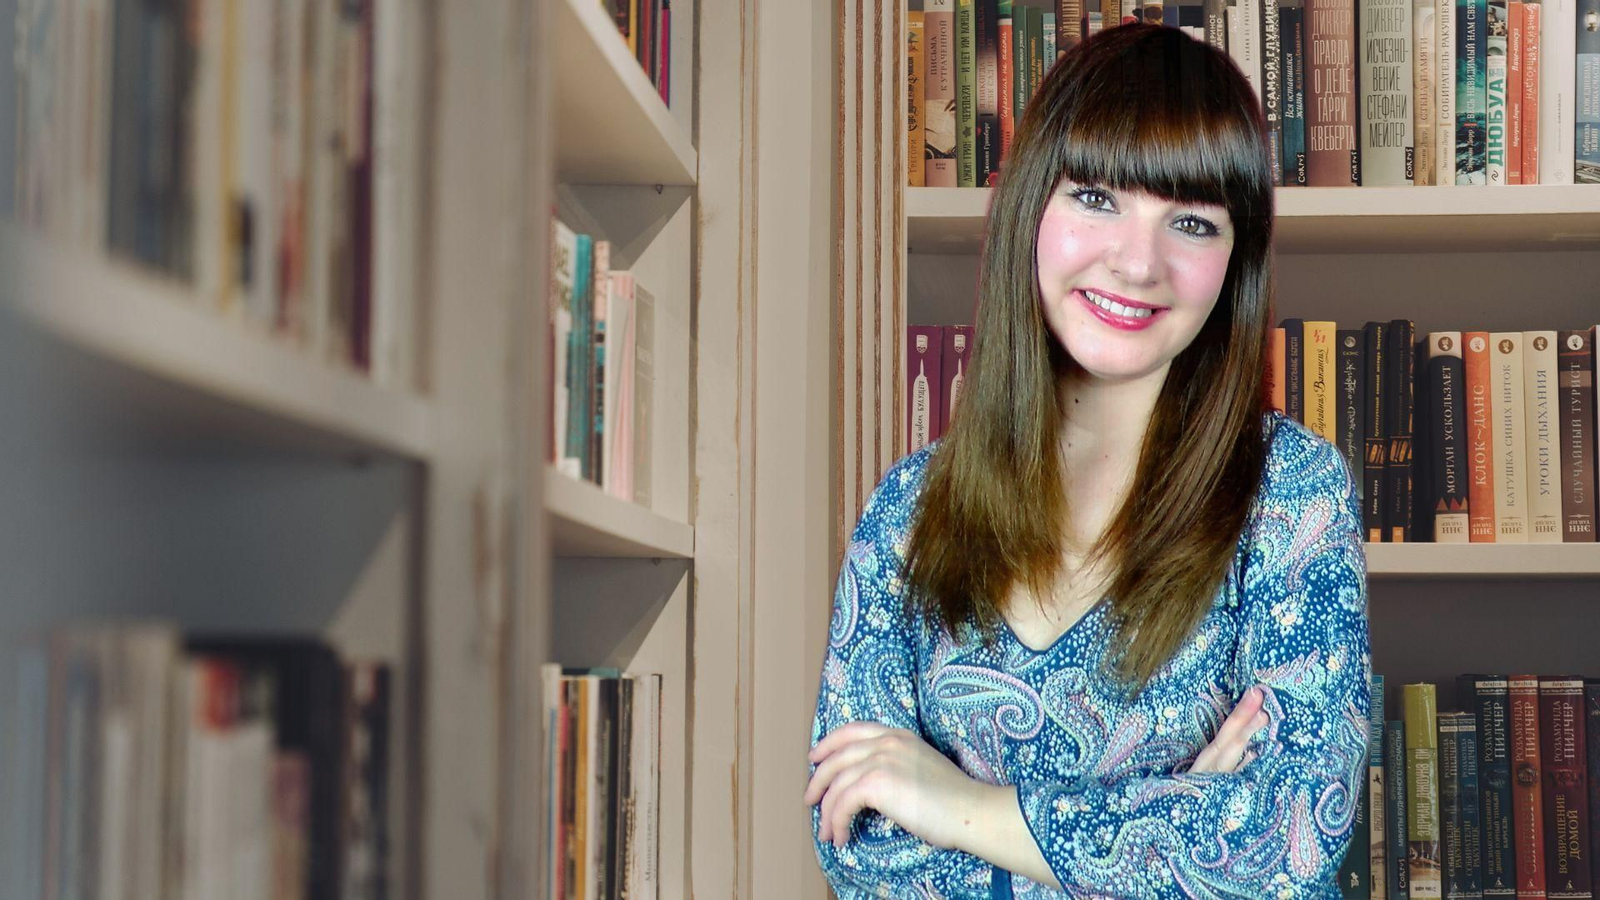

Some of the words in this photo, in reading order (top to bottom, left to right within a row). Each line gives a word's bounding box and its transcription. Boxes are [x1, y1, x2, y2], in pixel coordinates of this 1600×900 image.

[961, 9, 970, 33] КОНЦА
[961, 35, 970, 47] ИМ
[1312, 10, 1350, 40] ДИККЕР
[1366, 7, 1405, 37] ДИККЕР
[1466, 22, 1475, 40] НАМ
[939, 20, 947, 85] УТРАЧЕННОЙ
[961, 48, 970, 65] НЕТ
[1313, 39, 1350, 69] ПРАВДА
[1366, 38, 1409, 63] ИСЧЕЗНО-
[1420, 37, 1428, 82] ПАМЯТИ
[1511, 28, 1520, 71] Вице-консул
[1264, 62, 1276, 110] САМОЙ
[1286, 53, 1294, 102] оставшаяся
[1314, 69, 1321, 94] О
[1325, 68, 1351, 97] ДЕЛЕ
[1372, 66, 1401, 92] ВЕНИЕ
[1441, 51, 1449, 119] СОБИРАТЕЛЬ
[1465, 43, 1475, 97] НЕВИДИМЫЙ
[1526, 53, 1535, 100] НАСТОЯЩАЯ
[961, 85, 971, 123] ЧЕРЕПАХИ
[1267, 112, 1276, 122] В
[1285, 103, 1294, 119] Вся
[1317, 97, 1347, 122] ГАРРИ
[1366, 94, 1408, 120] СТЕФАНИ
[1420, 86, 1428, 121] СТЕНА
[1467, 99, 1475, 119] ВЕСЬ
[1488, 79, 1504, 167] ДЮБУА
[962, 141, 971, 160] ГРИН
[1310, 125, 1356, 151] КВЕБЕРТА
[1369, 119, 1405, 148] МЕЙЛЕР
[962, 161, 971, 182] ДЖОН
[1442, 365, 1453, 441] УСКОЛЬЗАЕТ
[1503, 364, 1512, 403] НИТОК
[1571, 363, 1581, 414] ТУРИСТ
[1536, 370, 1549, 443] ДЫХАНИЯ
[1504, 408, 1513, 447] СИНИХ
[1446, 446, 1455, 494] МОРГАН
[1505, 449, 1515, 507] КАТУШКА
[1540, 446, 1551, 496] УРОКИ
[1571, 418, 1583, 504] СЛУЧАЙНЫЙ
[1473, 528, 1493, 536] ЭНН
[1569, 525, 1591, 533] ЭНН
[1483, 700, 1493, 762] РОЗАМУНДА
[1494, 702, 1506, 758] ПИЛЧЕР
[1514, 700, 1523, 762] РОЗАМУНДА
[1524, 702, 1536, 758] ПИЛЧЕР
[1553, 700, 1563, 762] РОЗАМУНДА
[1564, 702, 1575, 758] ПИЛЧЕР
[1449, 739, 1457, 777] ПИЛЧЕР
[1468, 738, 1476, 776] ПИЛЧЕР
[1417, 803, 1431, 837] ЭДРИАН
[1556, 794, 1568, 874] ВОЗВРАЩЕНИЕ
[1568, 810, 1580, 860] ДОМОЙ
[1446, 821, 1455, 877] СОБИРАТЕЛИ
[1454, 826, 1462, 868] РАКУШЕК
[1465, 820, 1473, 877] СОБИРАТЕЛИ
[1472, 826, 1480, 868] РАКУШЕК
